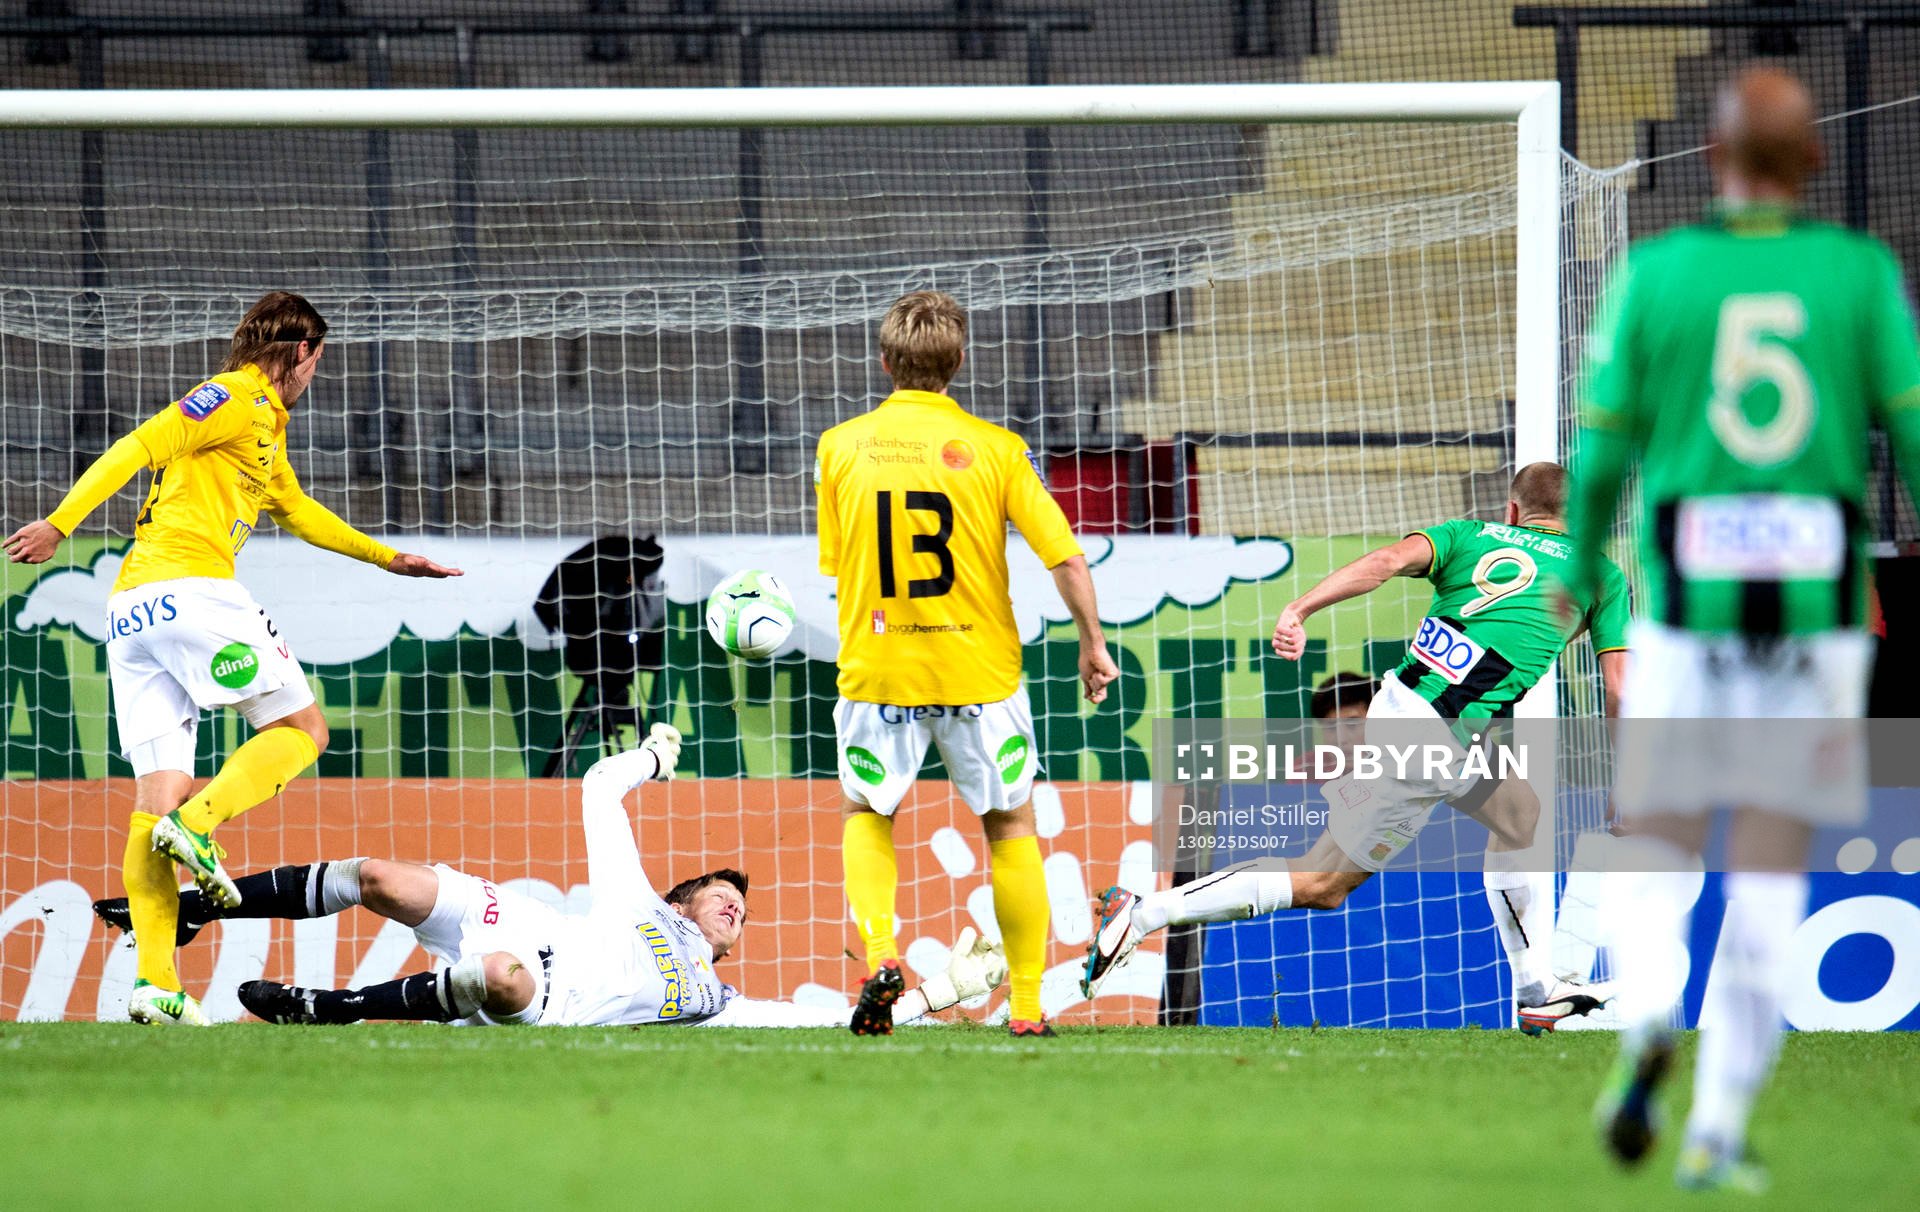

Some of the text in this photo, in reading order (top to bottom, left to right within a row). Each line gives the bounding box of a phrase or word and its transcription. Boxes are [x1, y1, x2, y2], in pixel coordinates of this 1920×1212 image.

[1708, 291, 1817, 469] 5
[868, 452, 927, 467] Sparbank
[877, 490, 955, 599] 13
[1460, 547, 1538, 618] 9
[214, 653, 256, 678] dina
[1417, 616, 1473, 670] BDO
[849, 752, 884, 775] dina
